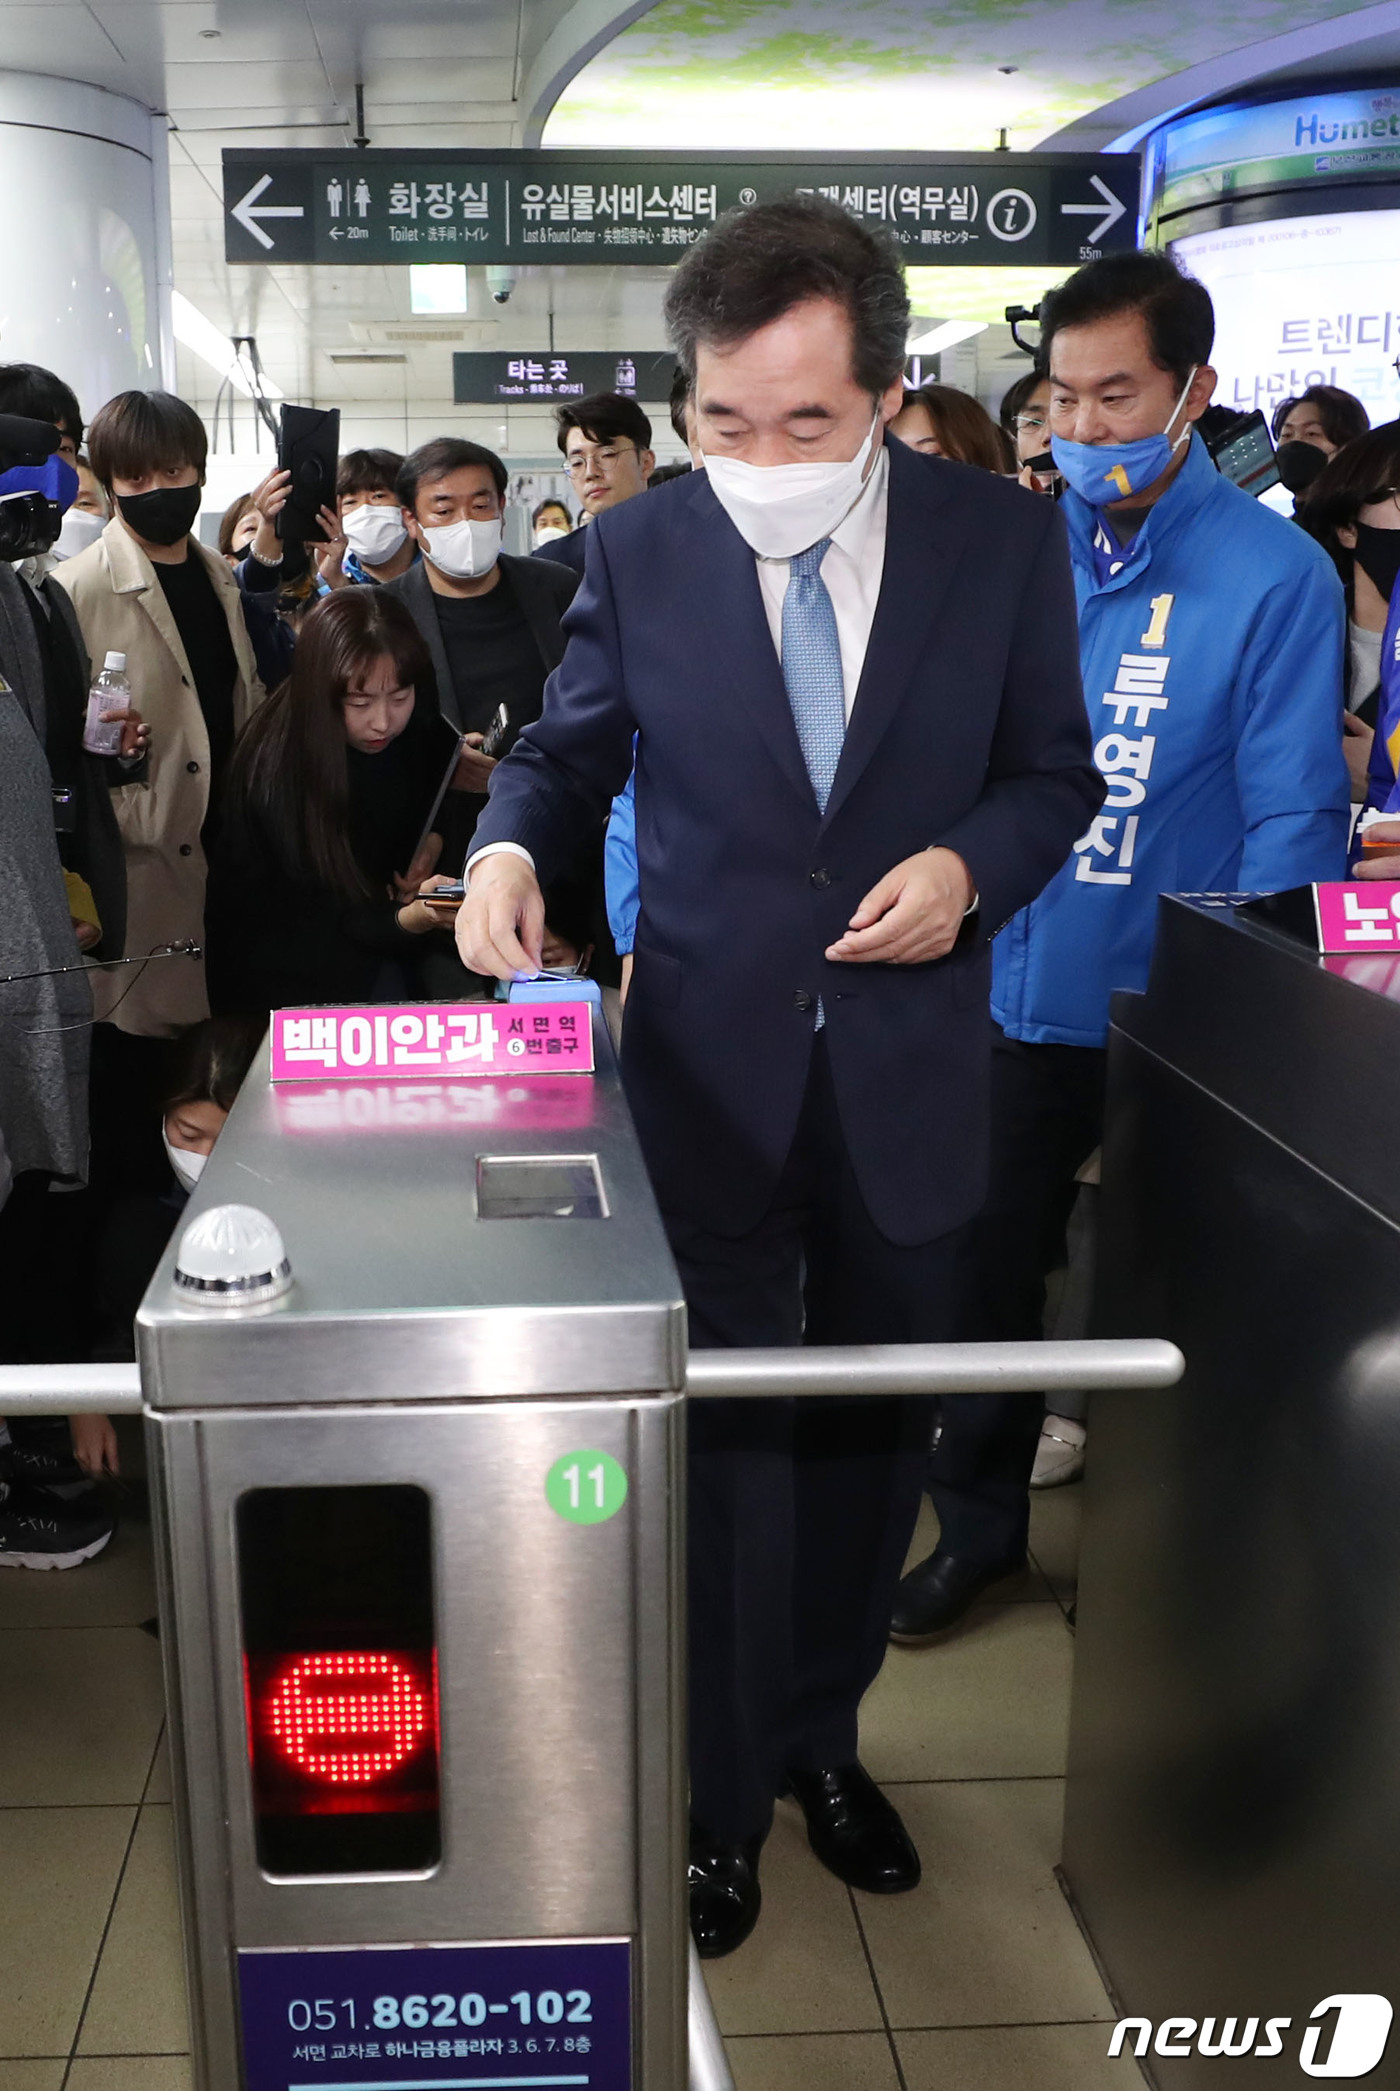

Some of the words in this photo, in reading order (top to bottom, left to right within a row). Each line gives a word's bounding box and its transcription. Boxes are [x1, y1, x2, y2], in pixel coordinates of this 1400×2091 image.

[388, 181, 490, 220] 화장실
[520, 184, 718, 222] 유실물서비스센터
[795, 184, 979, 222] 센터(역무실)
[347, 226, 369, 239] 20m
[388, 225, 419, 242] Toilet
[427, 225, 457, 242] 洗手间
[464, 226, 490, 242] トイレ
[522, 227, 539, 244] Lost
[540, 226, 546, 244] &
[547, 226, 570, 244] Found
[571, 226, 596, 244] Center
[920, 229, 979, 244] 顧客センター
[1079, 246, 1103, 260] 55m
[1277, 311, 1400, 355] 트렌디
[507, 359, 545, 381] 타는
[549, 359, 569, 381] 곳
[499, 384, 525, 395] Tracks
[1103, 465, 1132, 497] 1
[1141, 594, 1175, 649] 1
[1073, 653, 1171, 886] 류영진
[1343, 892, 1400, 942] 노
[282, 1013, 499, 1068] 백이안과
[562, 1463, 605, 1509] 11
[288, 1990, 593, 2032] 051.8620-102
[293, 2045, 326, 2061] 서면
[330, 2043, 382, 2060] 교차로
[385, 2038, 503, 2058] 하나금융플라자
[564, 2036, 592, 2053] 8층
